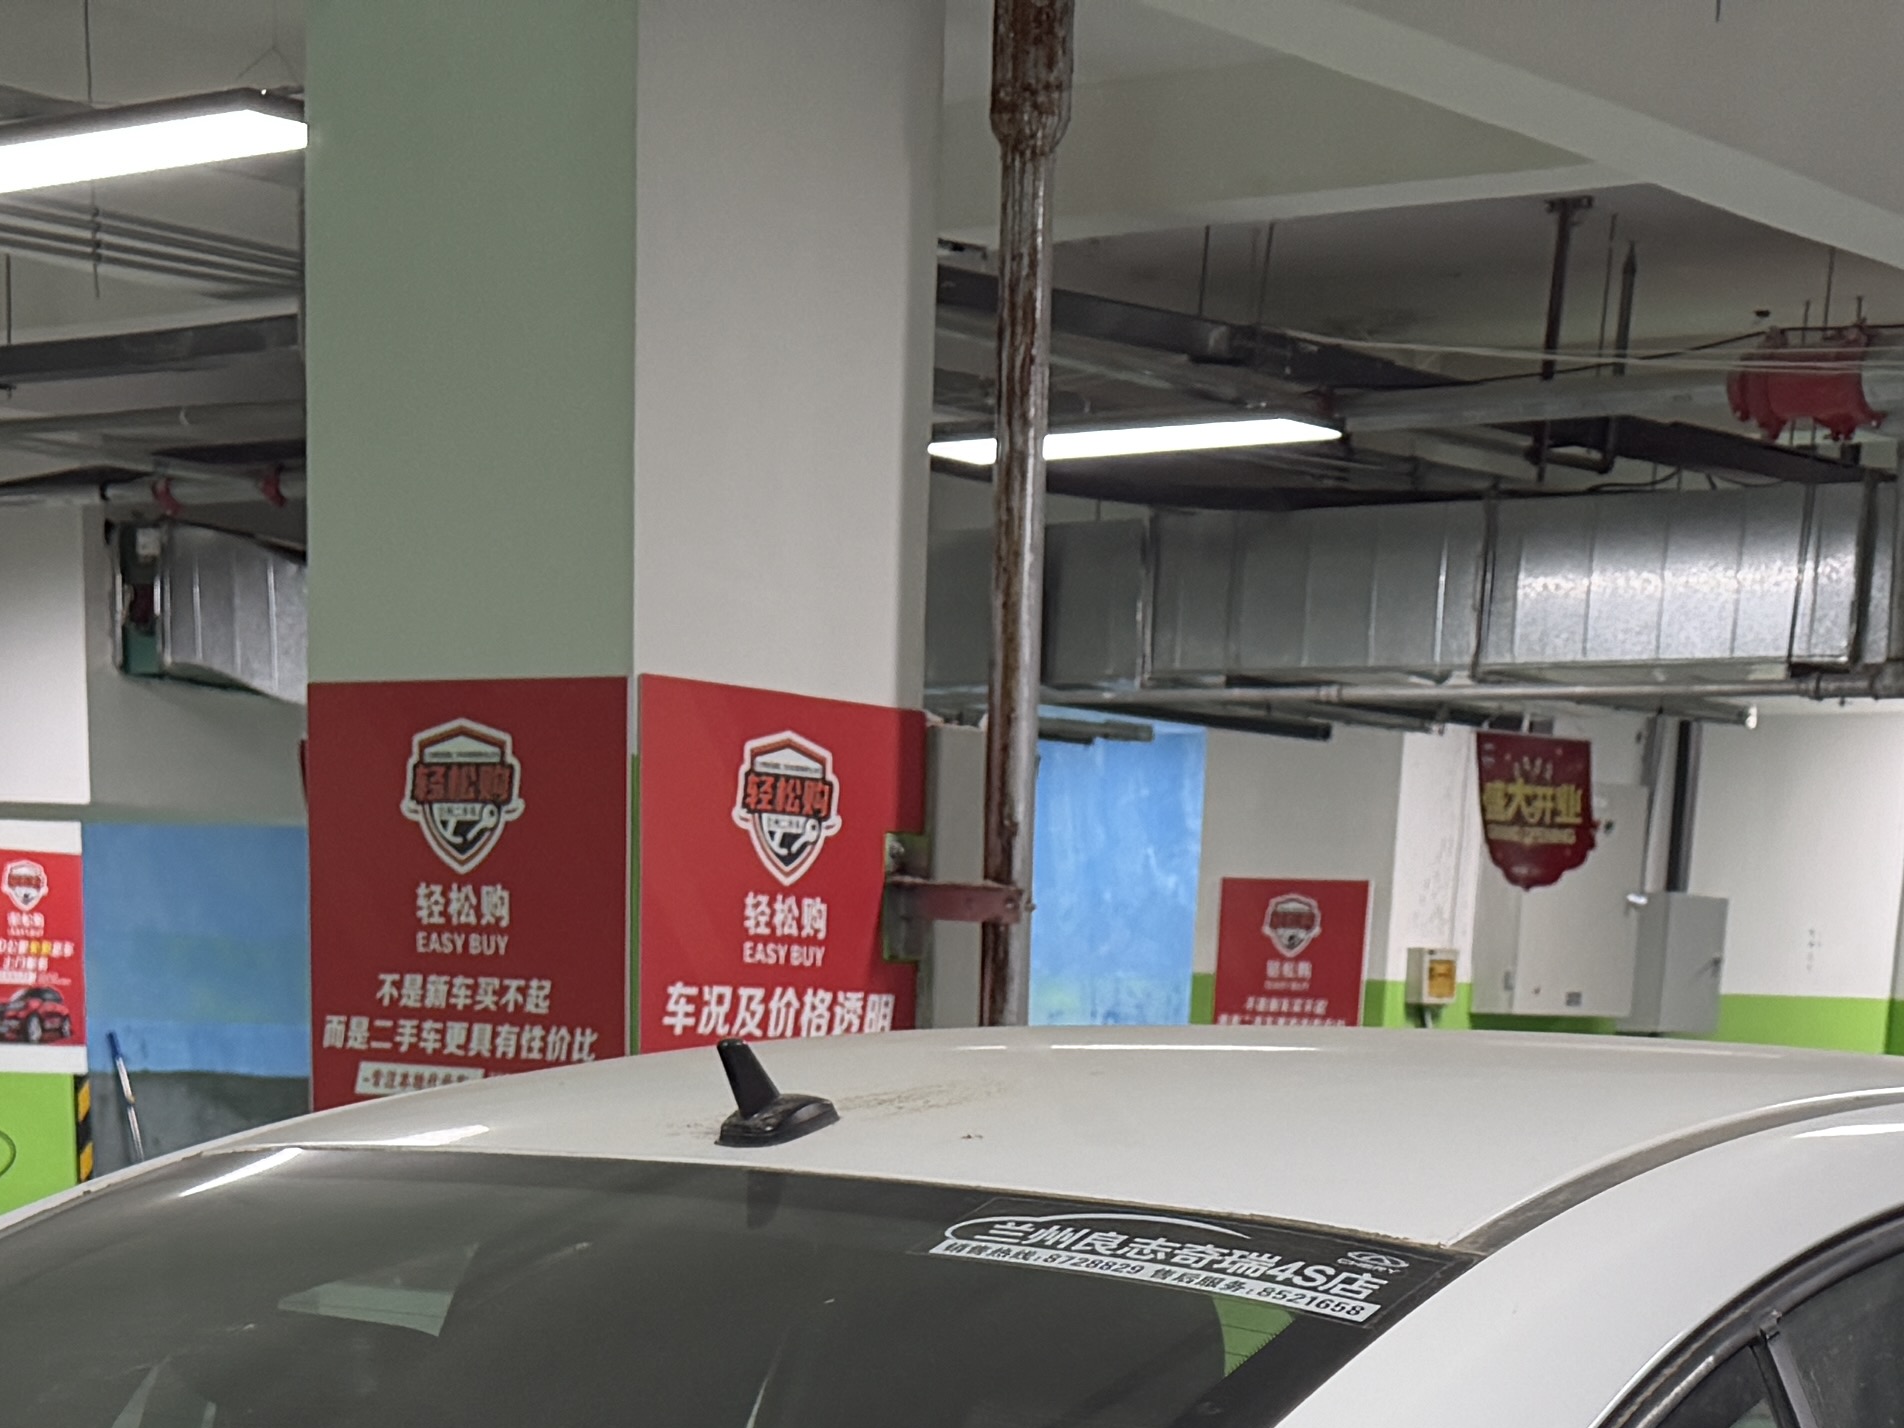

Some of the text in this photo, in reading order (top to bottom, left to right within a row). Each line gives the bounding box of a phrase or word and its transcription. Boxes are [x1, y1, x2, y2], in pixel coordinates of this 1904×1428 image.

[747, 773, 832, 818] 轻松购
[415, 882, 511, 928] 轻松购
[744, 891, 828, 940] 轻松购
[415, 931, 509, 956] EASY BUY
[743, 941, 826, 967] EASY BUY
[376, 973, 552, 1014] 不是新车买不起
[662, 980, 896, 1039] 车况及价格透明
[322, 1014, 599, 1063] 而是二手车更具有性价比
[973, 1221, 1389, 1300] 兰州良志奇瑞4S店
